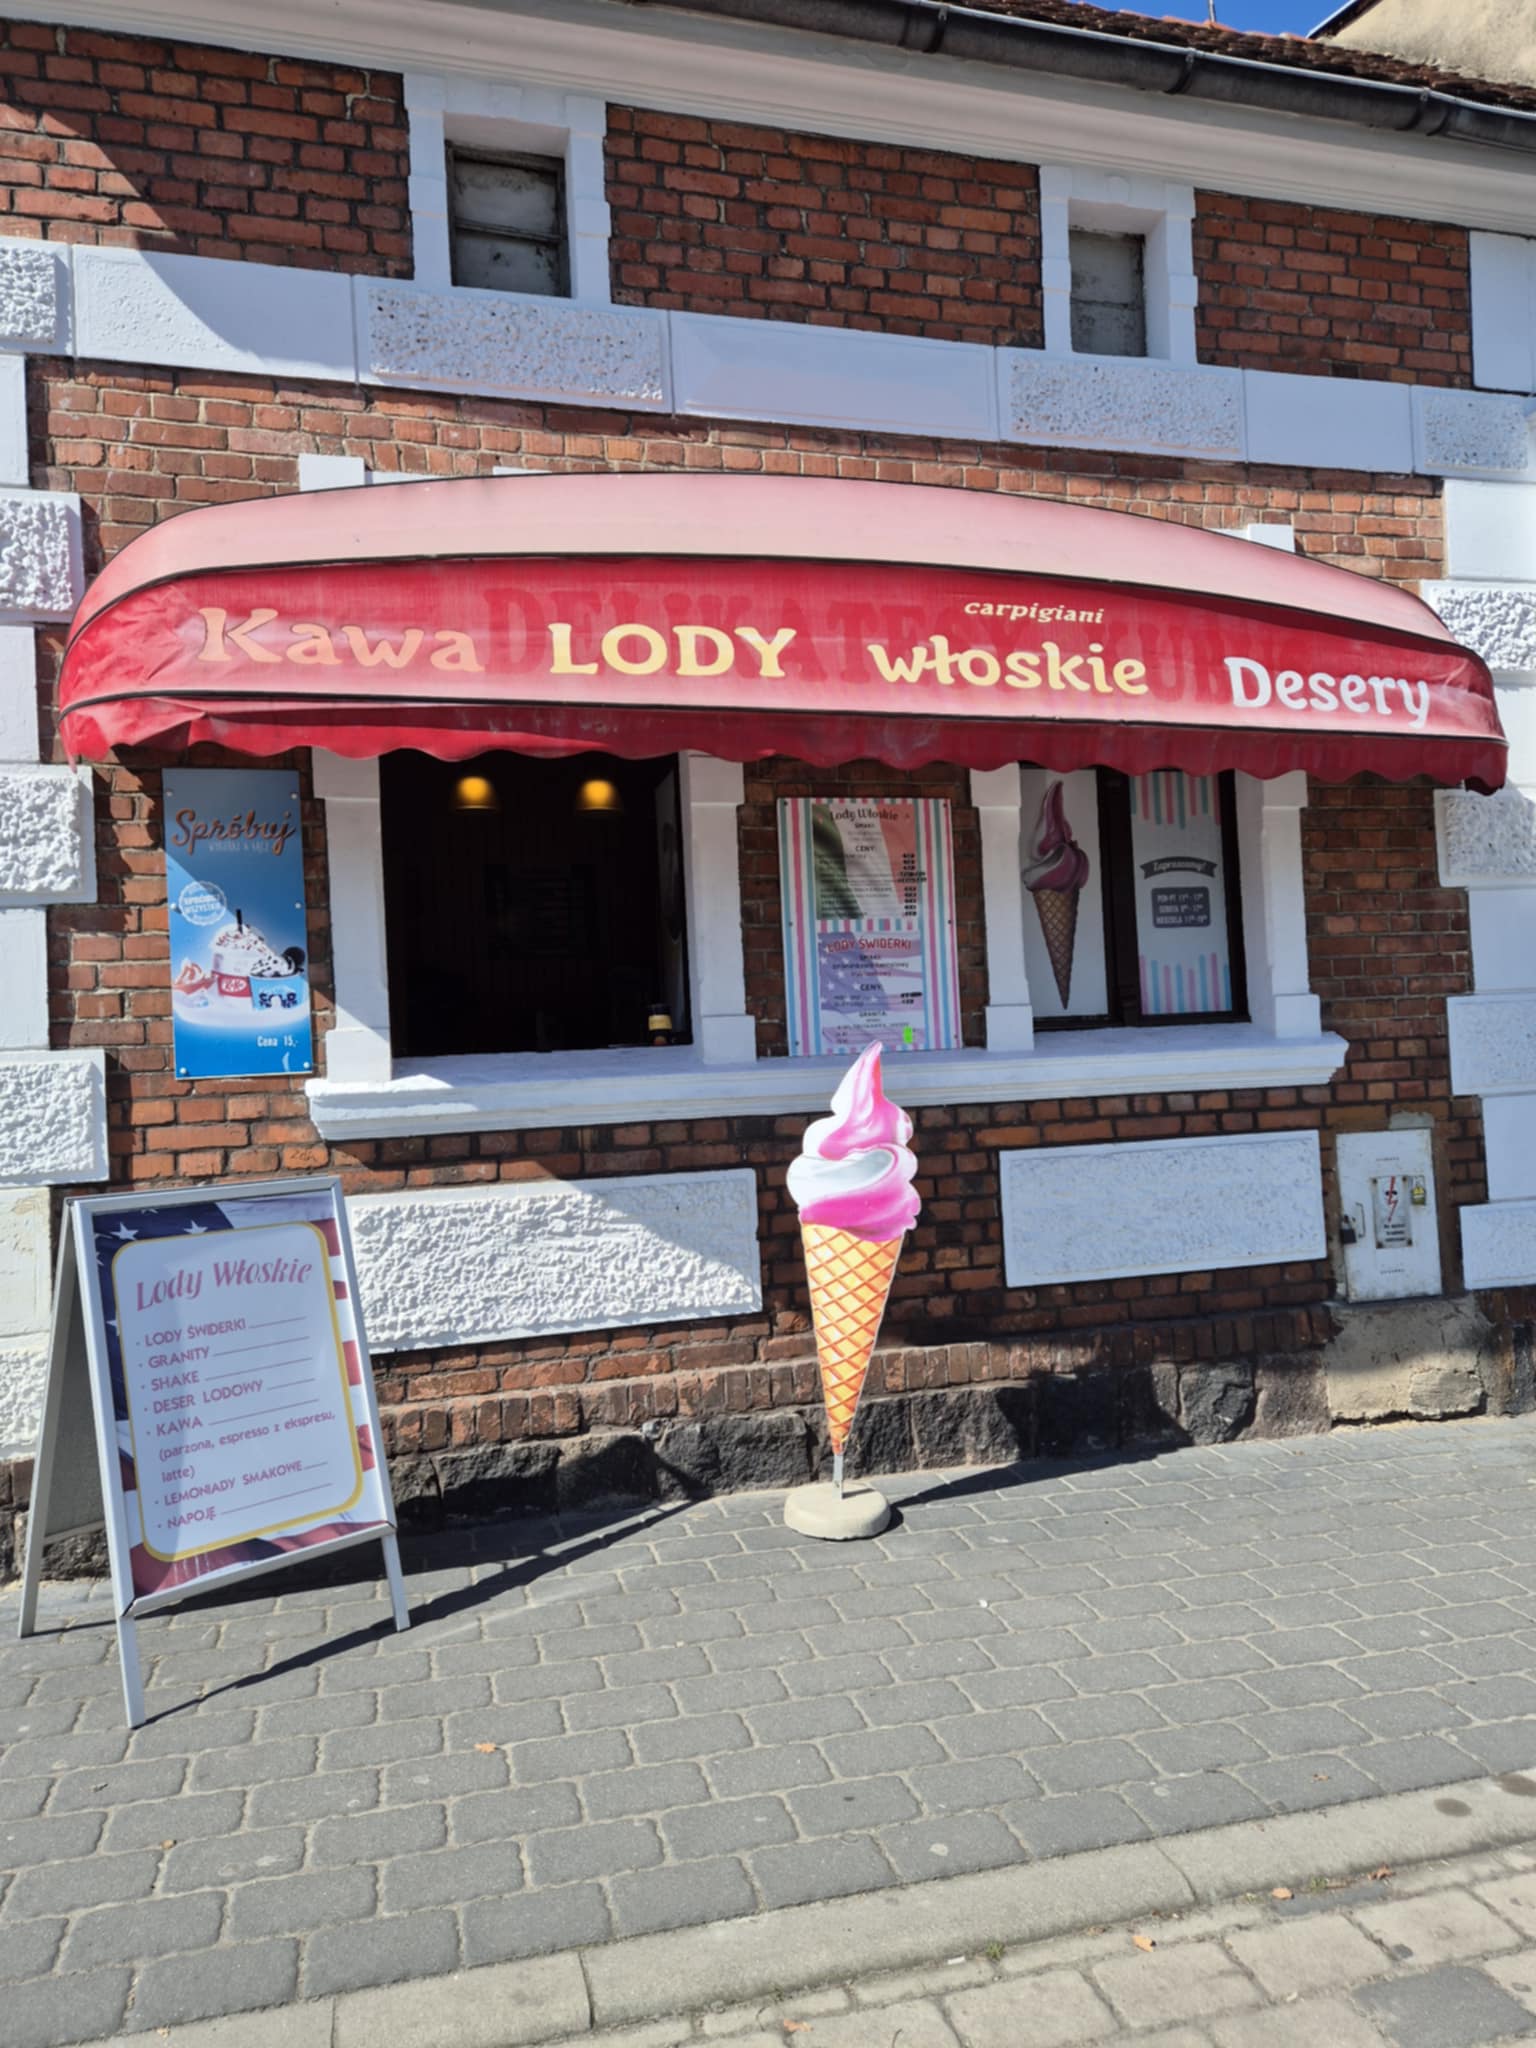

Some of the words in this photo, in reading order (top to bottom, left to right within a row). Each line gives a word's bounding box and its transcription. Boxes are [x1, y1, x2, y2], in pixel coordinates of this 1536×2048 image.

[964, 601, 1105, 625] carpigiani
[198, 607, 486, 673] Kawa
[549, 622, 797, 679] LODY
[868, 635, 1149, 696] włoskie
[1223, 656, 1431, 730] Desery
[171, 807, 298, 856] Spróbuj
[136, 1269, 203, 1312] Lody
[213, 1257, 312, 1288] Włoskie
[144, 1329, 182, 1347] LODY
[187, 1318, 247, 1340] ŚWIDERKI
[148, 1346, 210, 1369] GRANITY
[151, 1370, 200, 1392] SHAKE
[153, 1394, 196, 1415] DESER
[202, 1379, 264, 1404] LODOWY
[156, 1416, 203, 1437] KAWA
[219, 1425, 270, 1446] espresso
[274, 1424, 280, 1433] z
[161, 1465, 197, 1484] latte)
[164, 1477, 236, 1507] LEMONIADY
[242, 1460, 303, 1485] SMAKOWE
